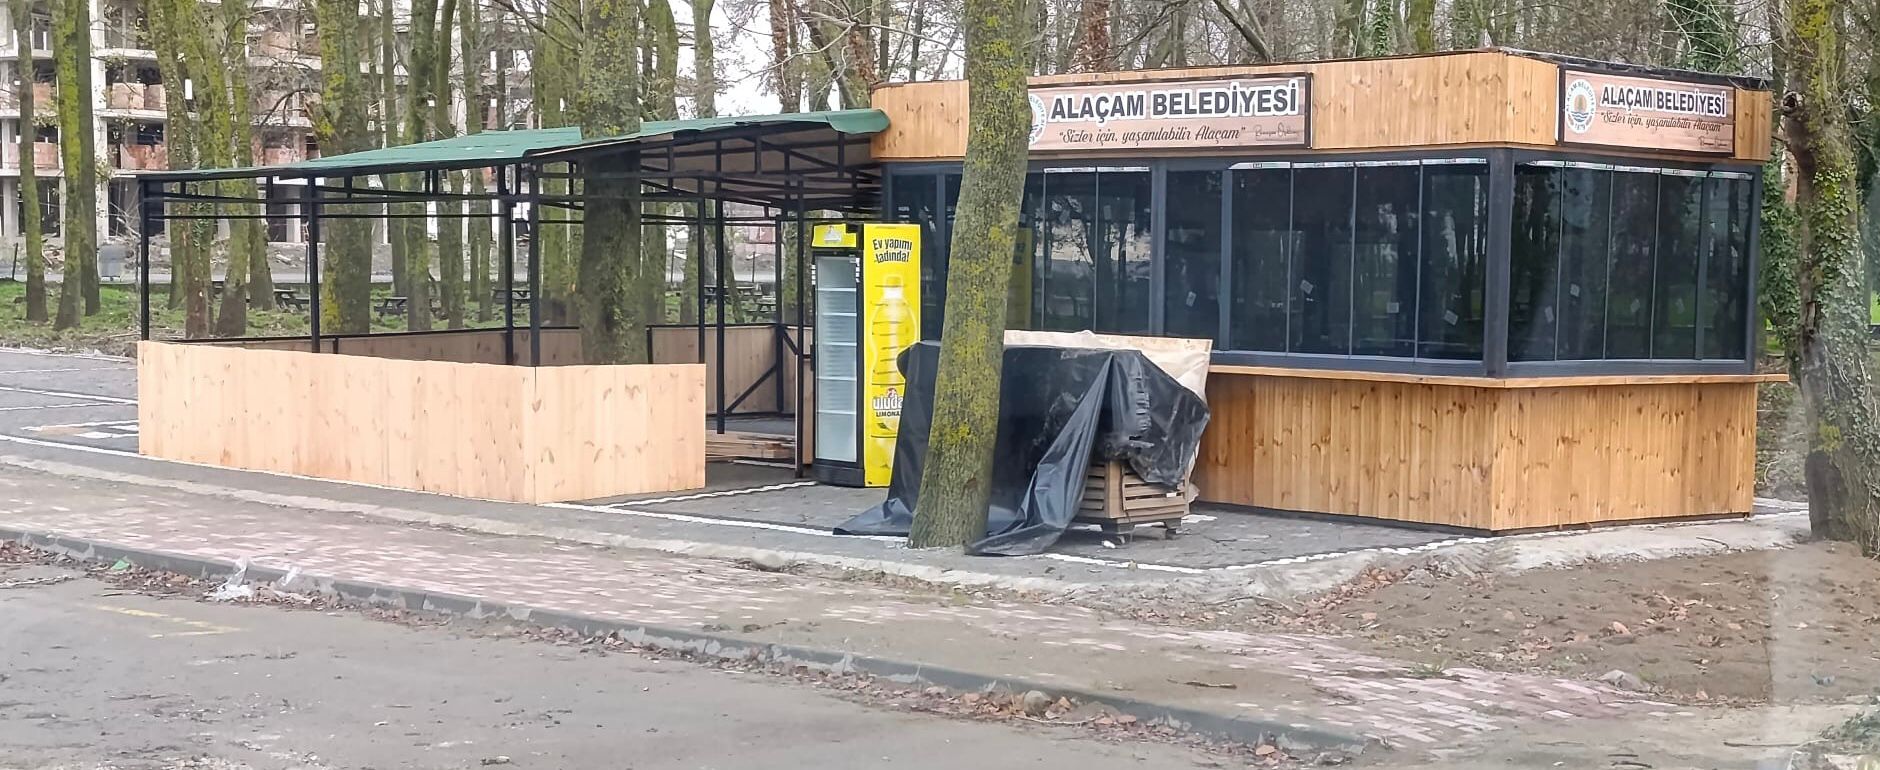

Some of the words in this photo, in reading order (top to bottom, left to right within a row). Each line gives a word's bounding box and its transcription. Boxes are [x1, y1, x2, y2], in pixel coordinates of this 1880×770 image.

[1051, 93, 1144, 123] ALAÇAM
[1152, 82, 1297, 116] BELEDİYESİ
[1601, 86, 1652, 111] ALAÇAM
[1656, 88, 1726, 116] BELEDİYESİ
[1121, 126, 1191, 147] yaşanılabilir
[872, 238, 883, 251] Ev
[885, 239, 912, 251] yapımı
